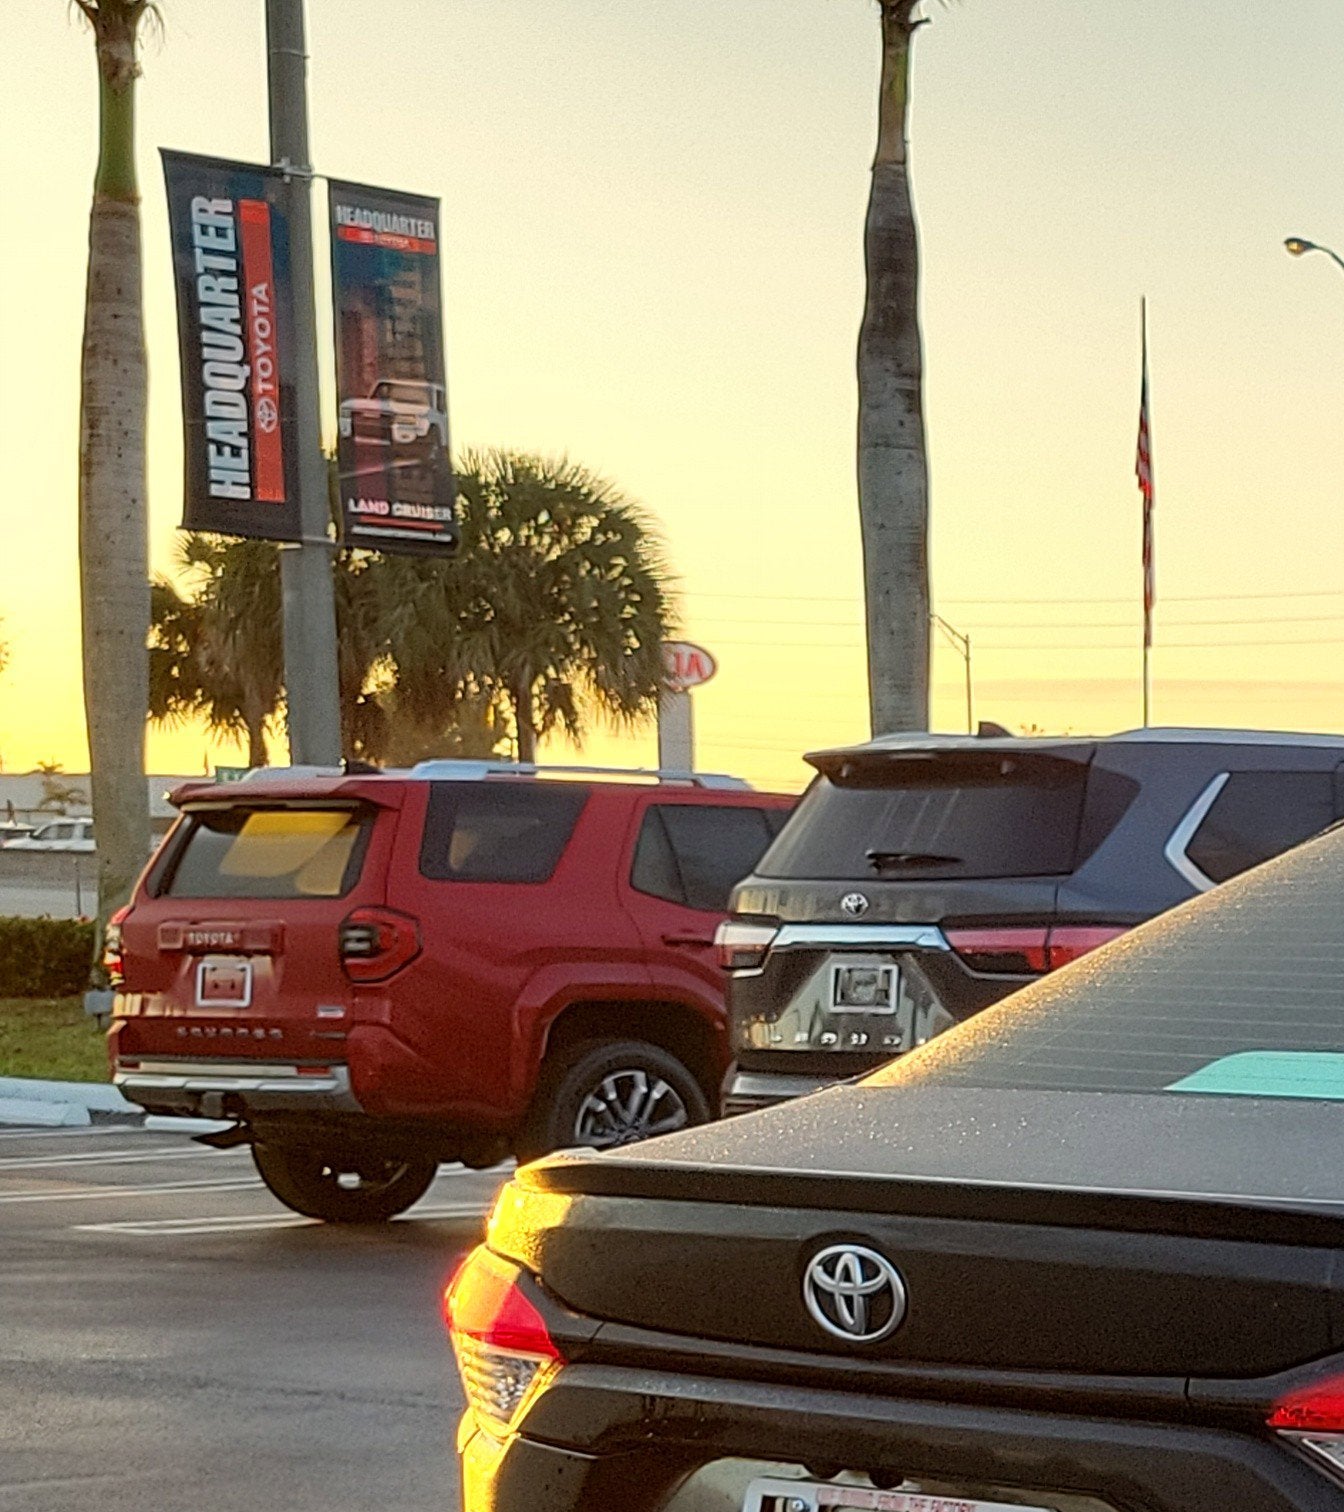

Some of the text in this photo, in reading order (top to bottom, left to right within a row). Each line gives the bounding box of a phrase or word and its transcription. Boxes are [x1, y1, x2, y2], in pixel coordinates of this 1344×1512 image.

[336, 205, 435, 239] HEADQUARTER
[192, 195, 251, 500] HEADQUARTER
[251, 283, 273, 394] TOYOTA
[348, 498, 453, 521] LAND CRUISER
